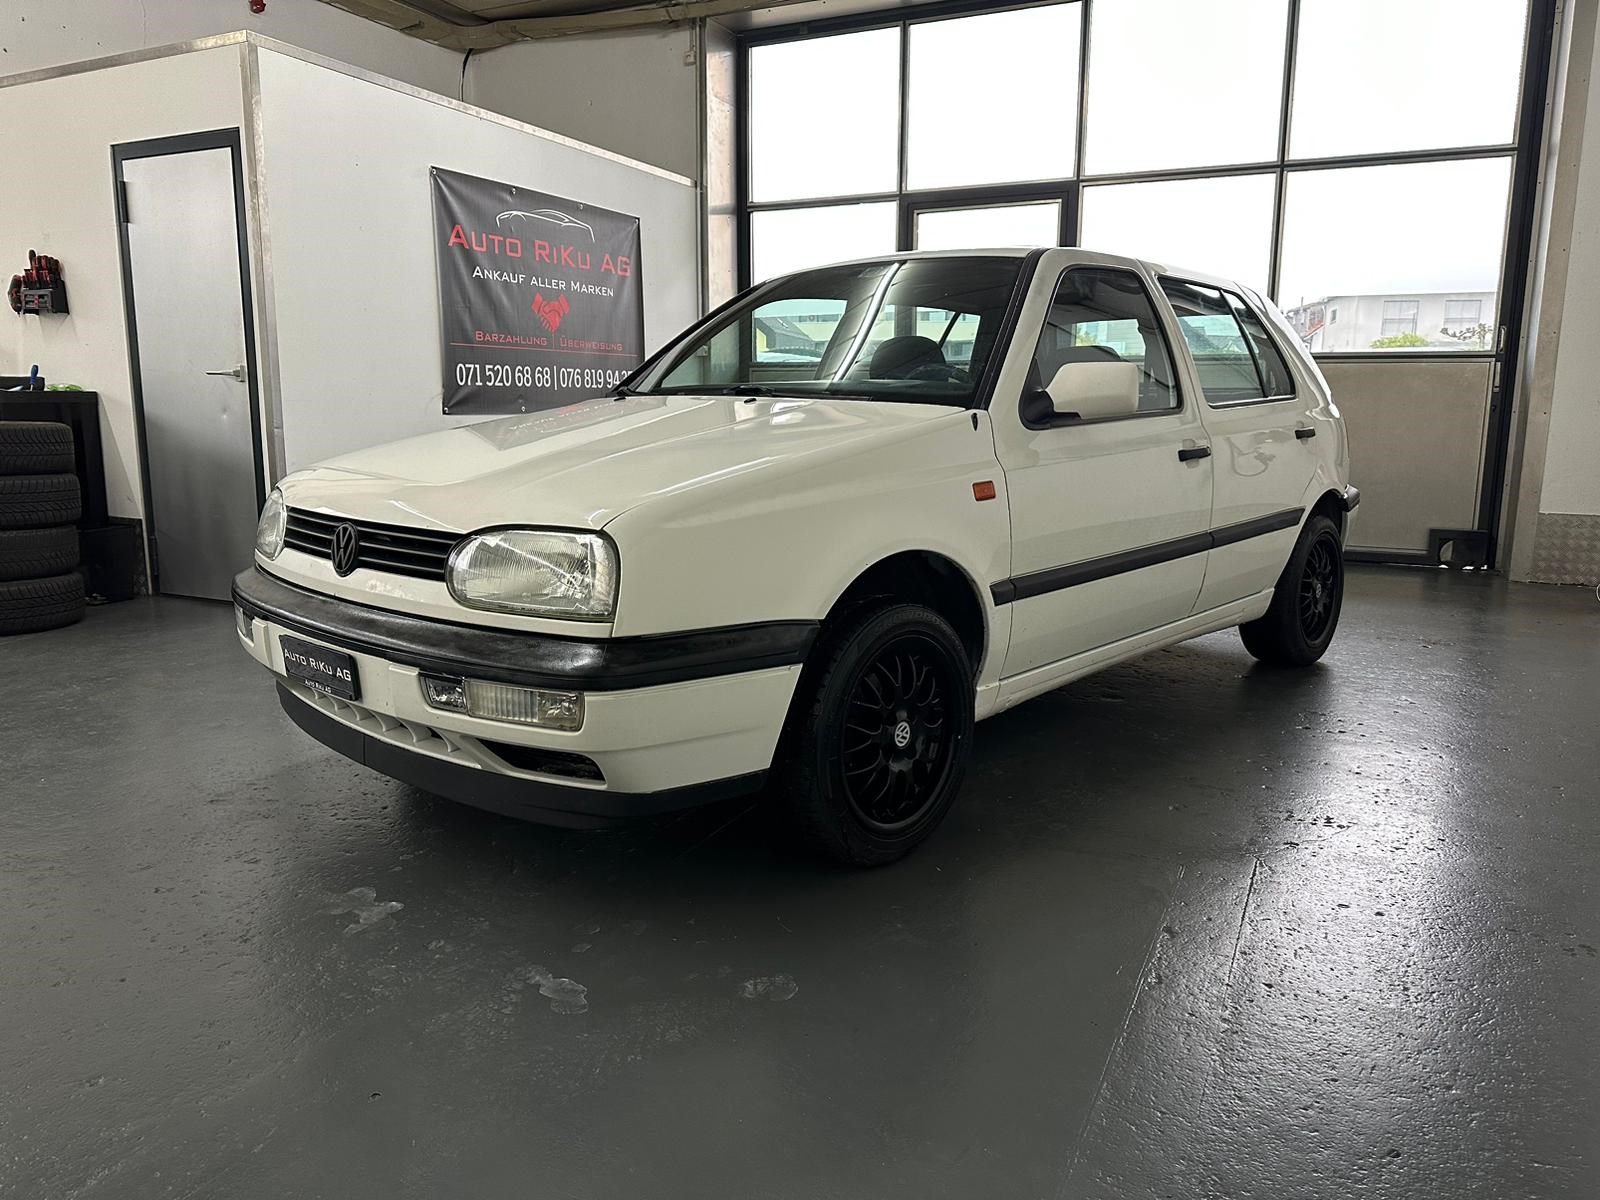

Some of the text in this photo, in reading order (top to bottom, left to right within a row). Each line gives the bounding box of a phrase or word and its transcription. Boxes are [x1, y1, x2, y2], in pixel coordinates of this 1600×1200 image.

[448, 224, 522, 258] AUTO
[601, 253, 631, 277] AG
[472, 266, 614, 297] ANKAUF ALLER MARKEN
[475, 331, 548, 346] BARZAHLUNG
[456, 363, 482, 386] 071
[485, 365, 512, 387] 520
[515, 366, 532, 387] 68
[535, 367, 551, 387] 68
[560, 368, 582, 388] 076
[584, 369, 604, 388] 819
[284, 649, 307, 665] AUTO
[336, 667, 351, 681] AG
